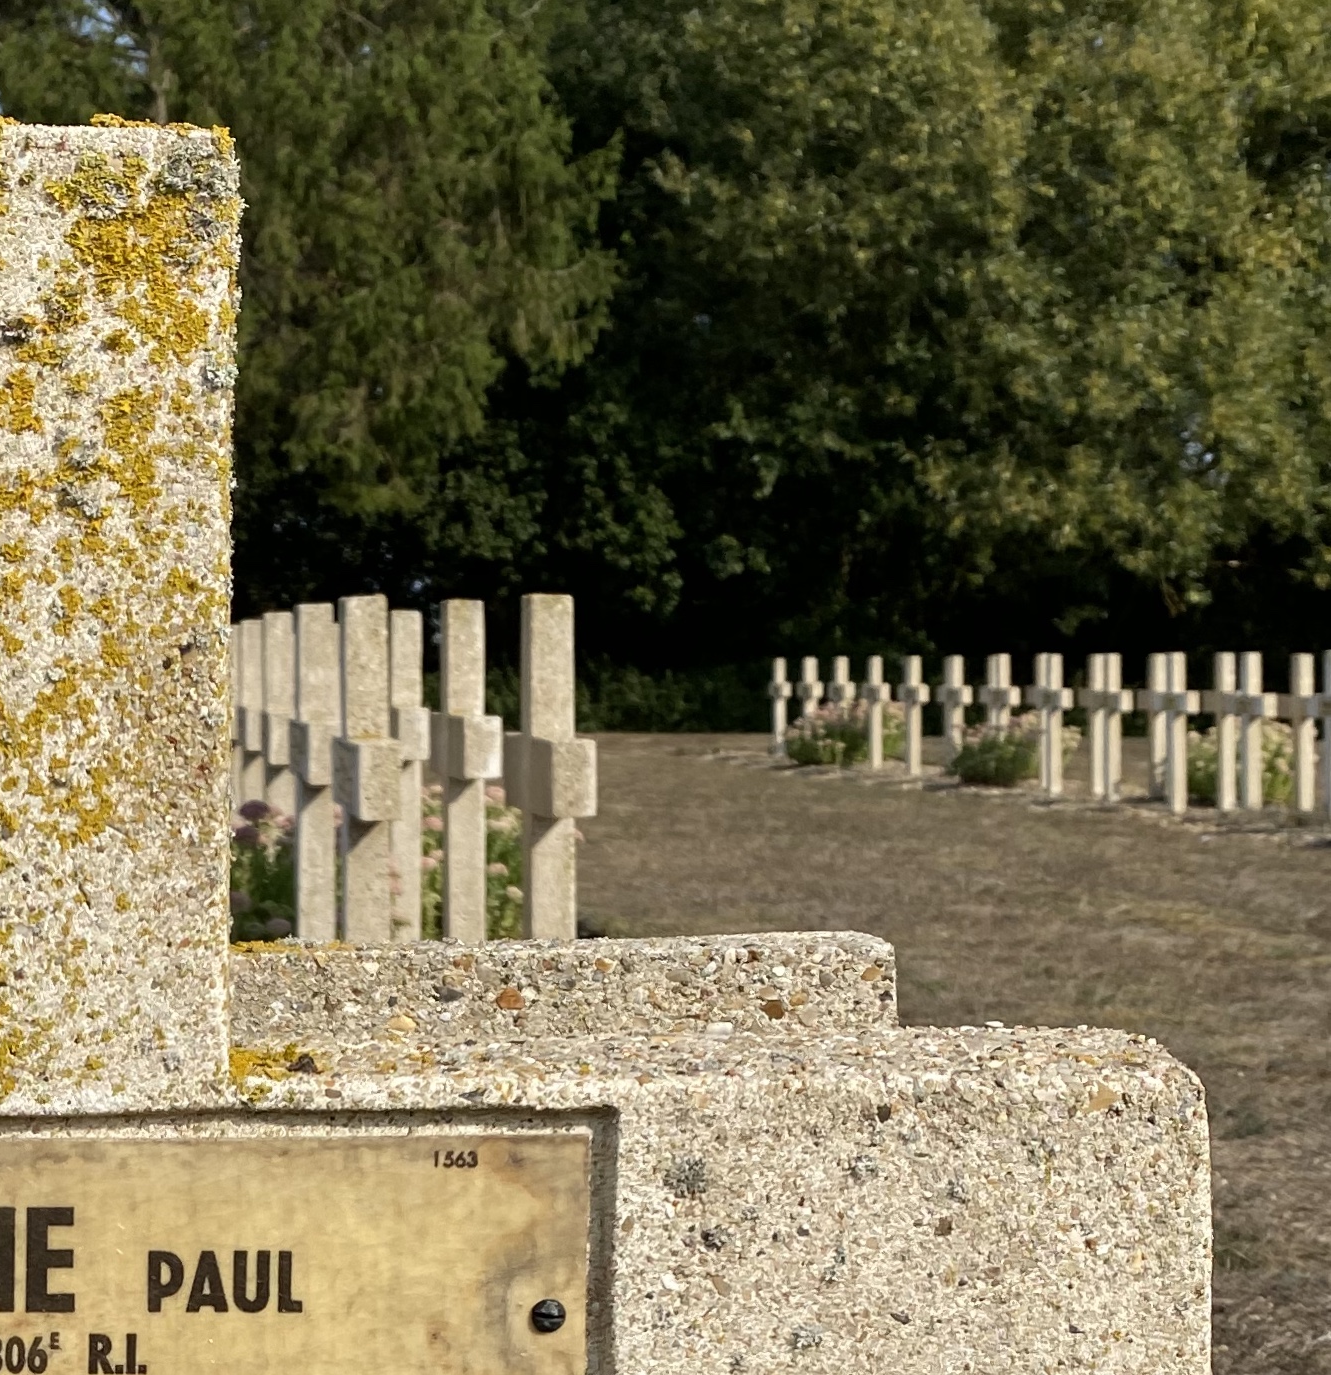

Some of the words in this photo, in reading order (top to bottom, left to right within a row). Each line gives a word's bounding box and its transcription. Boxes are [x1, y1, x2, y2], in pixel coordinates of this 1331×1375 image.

[433, 1150, 480, 1169] 1563
[146, 1250, 304, 1315] PAUL
[87, 1332, 149, 1375] R.I.
